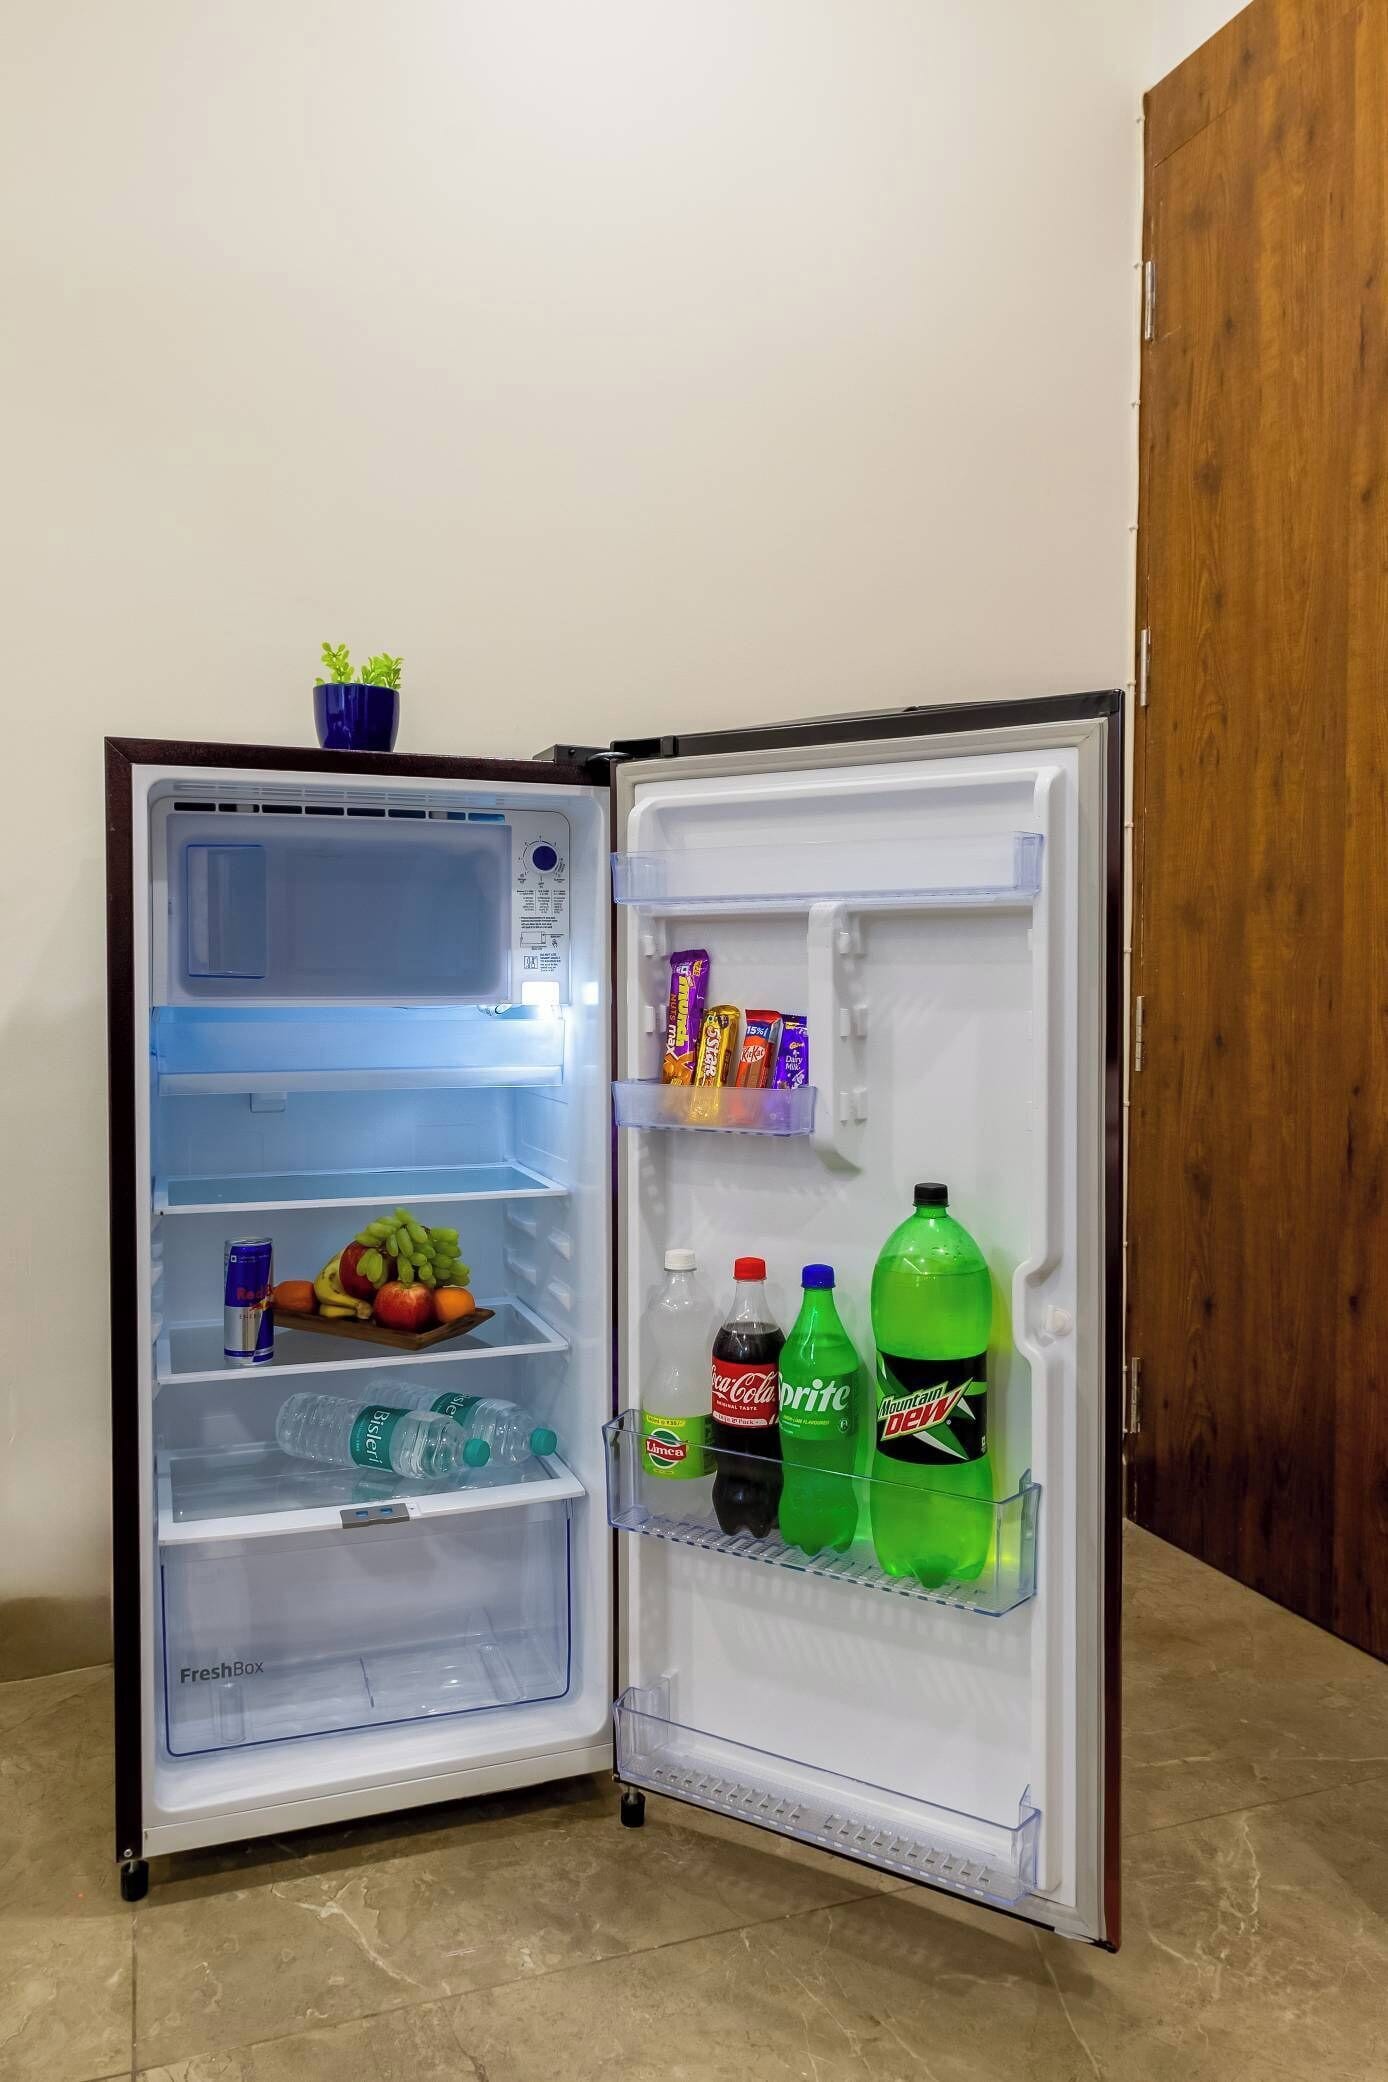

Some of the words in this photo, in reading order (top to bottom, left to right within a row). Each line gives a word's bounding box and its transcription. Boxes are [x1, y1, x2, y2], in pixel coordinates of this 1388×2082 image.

[785, 1062, 801, 1071] Milk
[786, 1055, 803, 1065] Dairy
[777, 1371, 851, 1412] prite
[878, 1384, 945, 1418] Mountain
[365, 1410, 390, 1464] Bisleri
[646, 1441, 685, 1457] Limca
[180, 1661, 264, 1684] FreshBox
